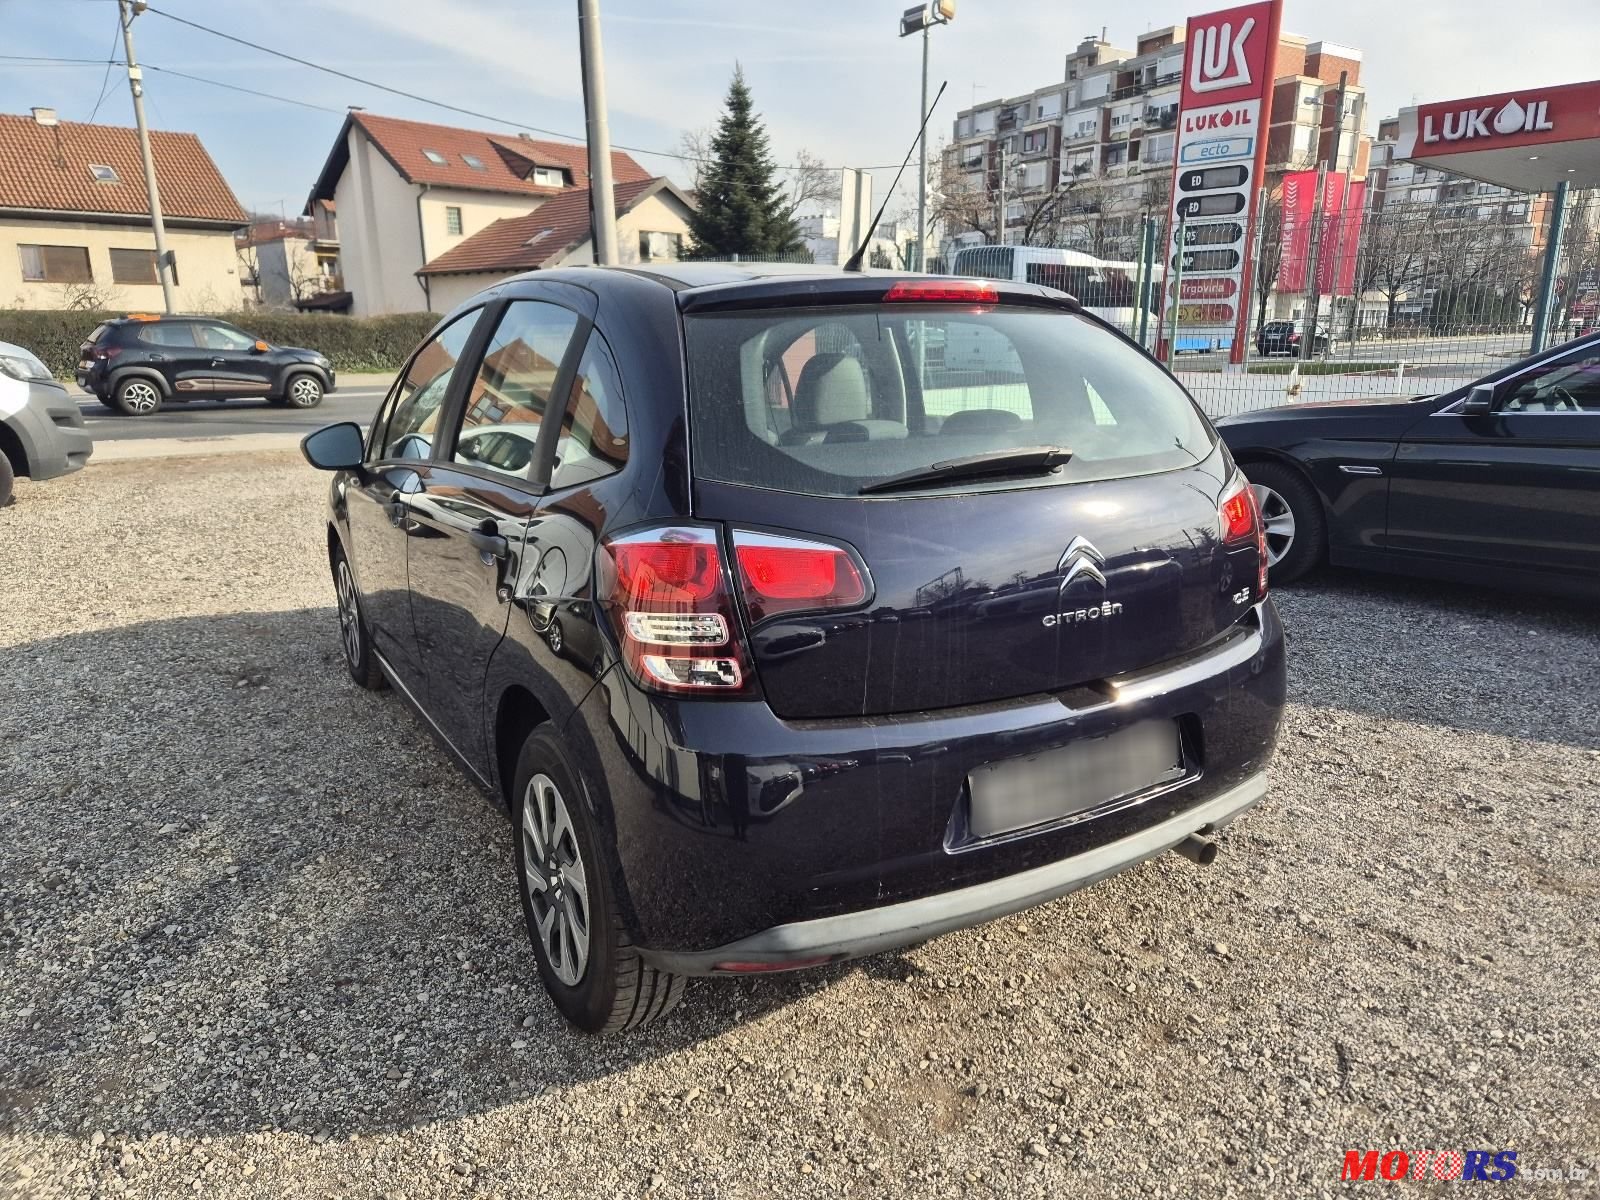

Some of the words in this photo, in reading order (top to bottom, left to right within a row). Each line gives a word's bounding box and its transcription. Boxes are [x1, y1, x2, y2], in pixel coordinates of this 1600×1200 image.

[1185, 108, 1252, 133] LUKOIL
[1423, 98, 1553, 144] LUKOIL
[1200, 143, 1230, 157] ecto
[1191, 175, 1202, 187] ED
[1181, 283, 1225, 296] Trgovina
